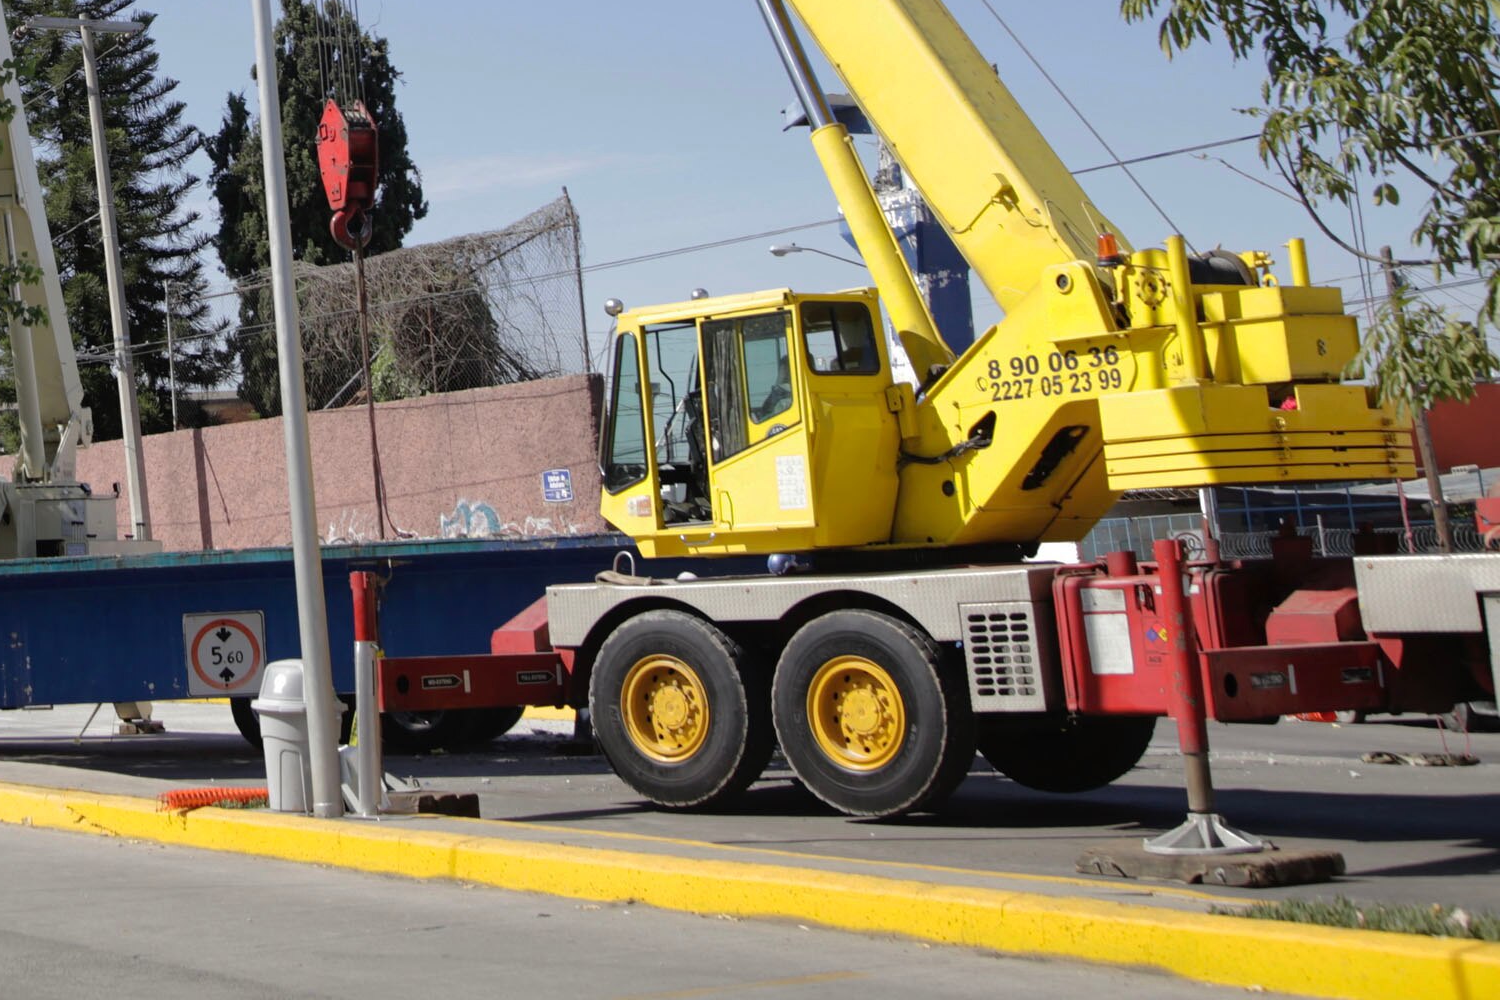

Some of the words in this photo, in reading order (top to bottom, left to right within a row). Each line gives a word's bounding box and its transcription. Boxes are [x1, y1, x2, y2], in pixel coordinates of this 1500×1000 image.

[988, 359, 1002, 380] 8
[1009, 355, 1040, 377] 90
[1048, 350, 1079, 373] 06
[1088, 344, 1120, 368] 36
[990, 378, 1034, 402] 2227
[1041, 374, 1063, 396] 05
[1069, 371, 1093, 394] 23
[1098, 368, 1122, 390] 99
